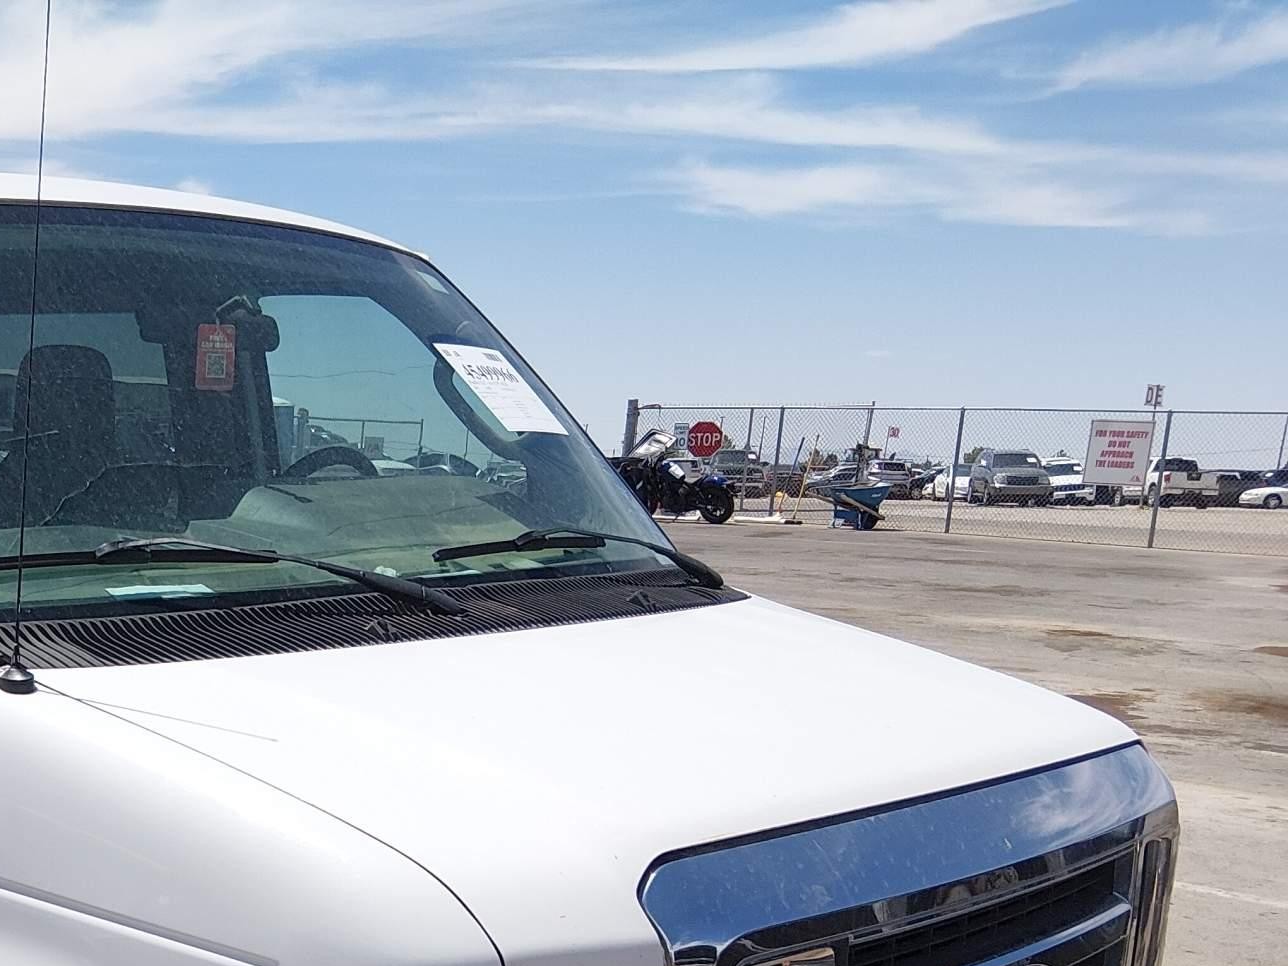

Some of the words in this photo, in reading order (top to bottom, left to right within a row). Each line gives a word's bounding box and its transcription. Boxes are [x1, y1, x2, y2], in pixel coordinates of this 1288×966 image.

[462, 363, 519, 383] 45499966
[1109, 430, 1125, 438] YOUR
[1126, 431, 1149, 439] SAFETY
[675, 437, 686, 447] 10
[688, 433, 721, 447] STOP
[1108, 440, 1117, 448] DO
[1117, 440, 1131, 448] NOT
[1100, 450, 1134, 458] APPROACH
[1096, 460, 1107, 468] THE
[1107, 460, 1135, 469] LOADERS
